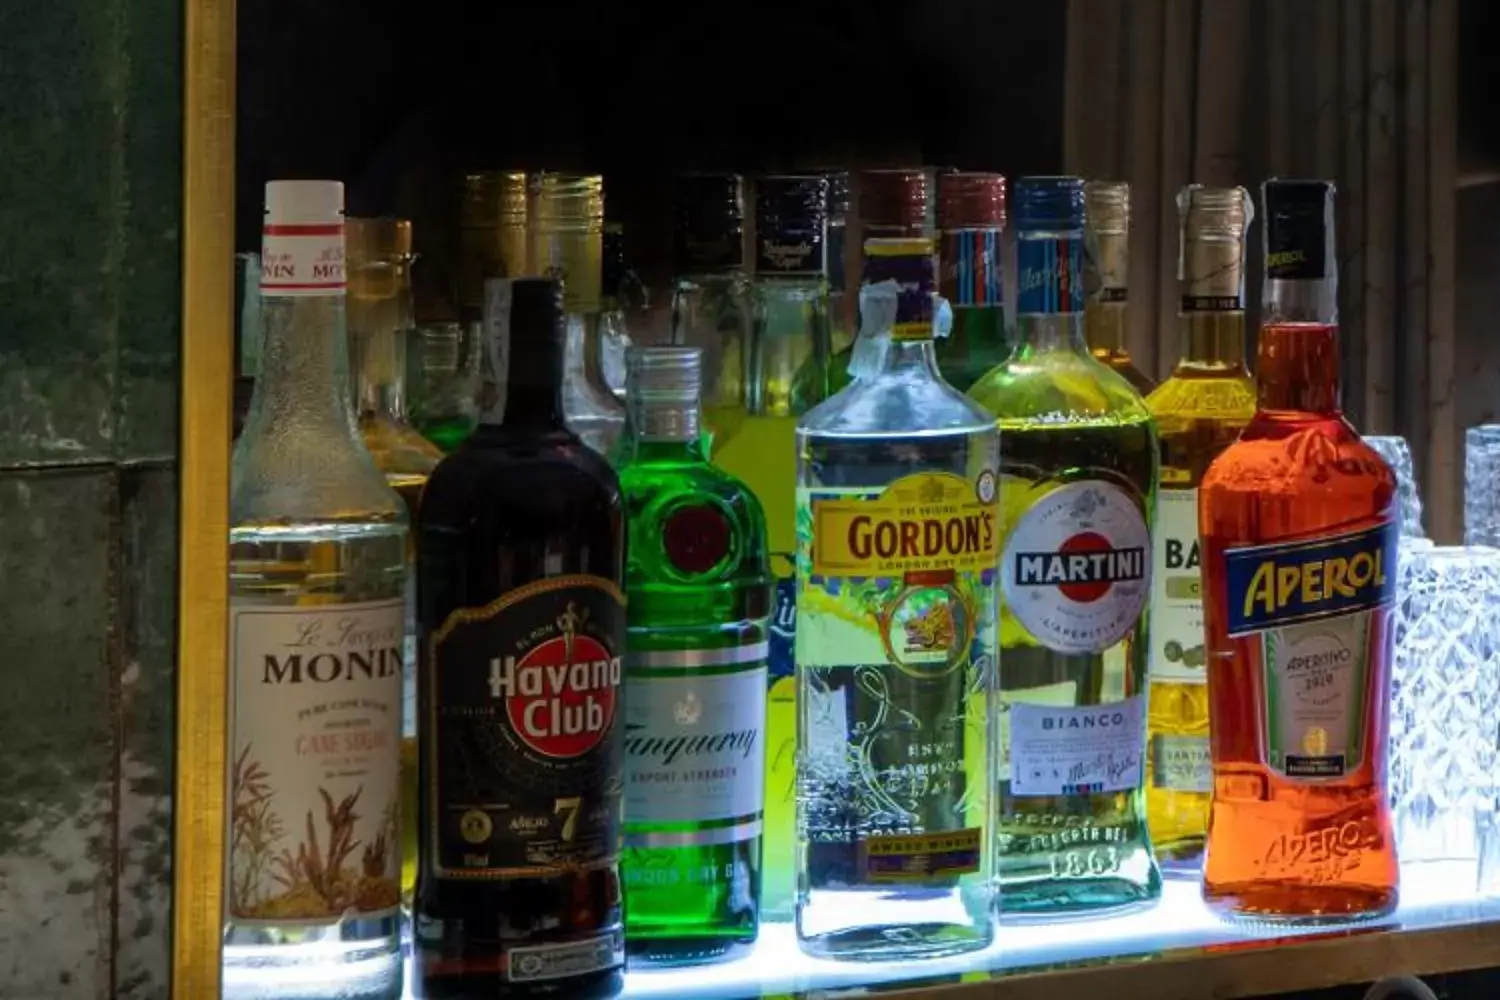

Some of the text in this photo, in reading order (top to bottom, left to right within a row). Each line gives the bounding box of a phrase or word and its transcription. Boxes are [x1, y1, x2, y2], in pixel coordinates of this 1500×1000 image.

[847, 510, 993, 560] GORDON'S
[1165, 539, 1201, 570] BA
[1021, 550, 1142, 583] MARTINI
[1243, 548, 1387, 618] APEROL
[261, 646, 404, 684] MONIN
[488, 654, 623, 698] Havana
[523, 695, 604, 738] Club
[1042, 712, 1124, 731] BIANCO
[554, 797, 582, 842] 7
